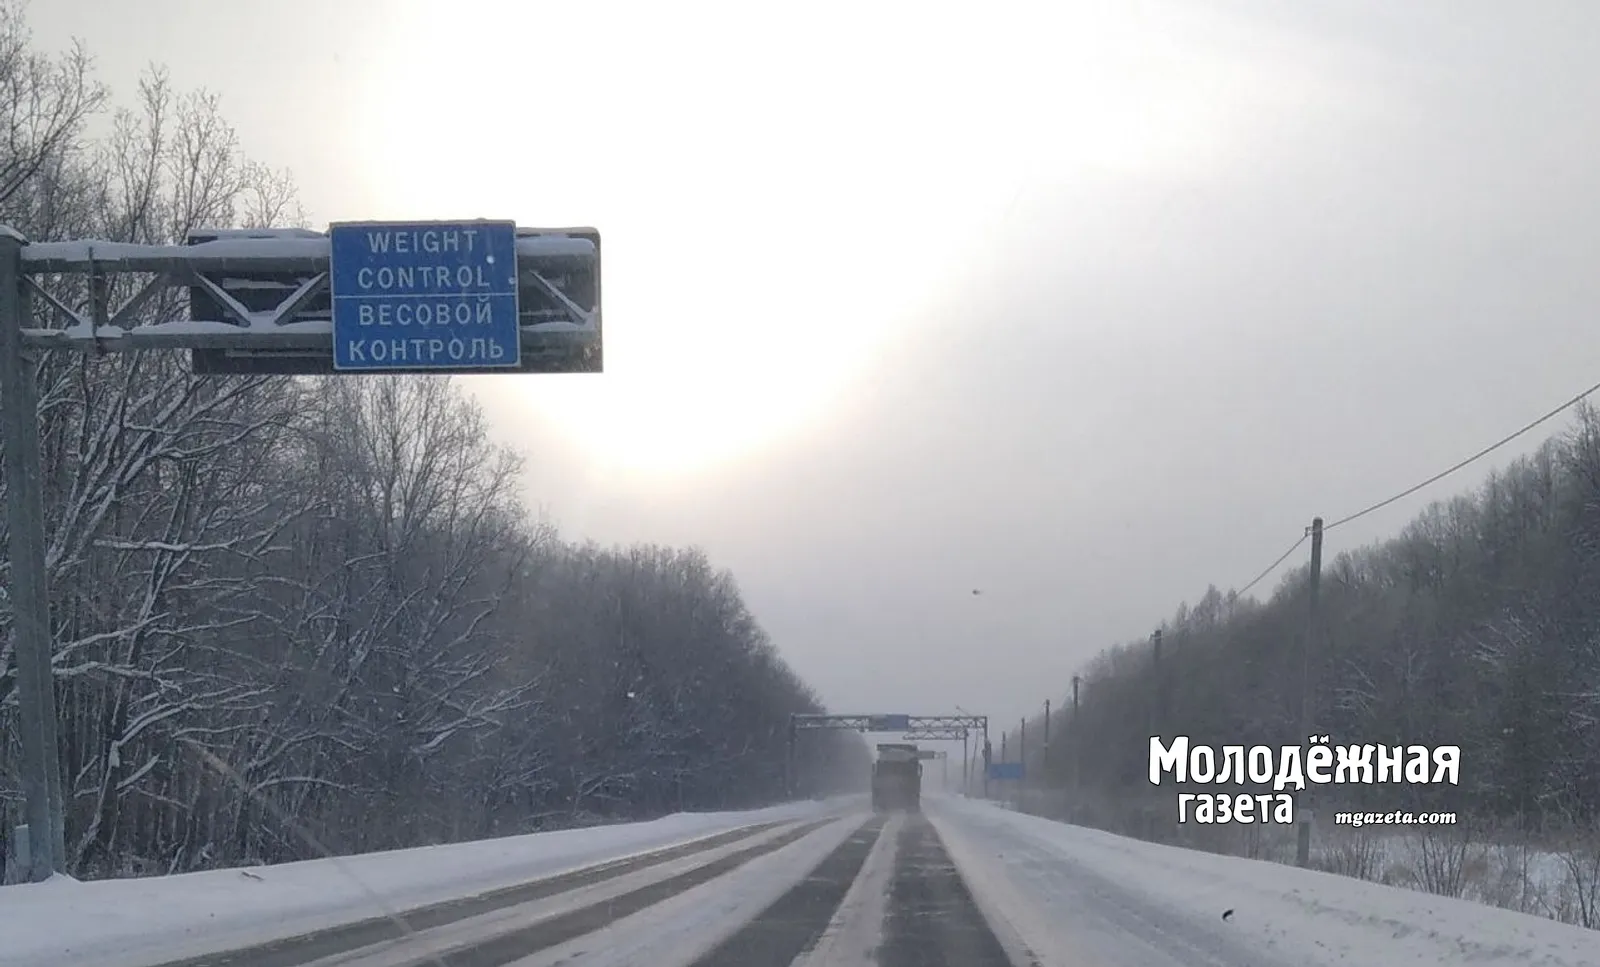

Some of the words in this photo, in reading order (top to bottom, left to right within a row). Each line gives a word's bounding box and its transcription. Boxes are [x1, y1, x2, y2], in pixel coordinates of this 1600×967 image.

[367, 230, 477, 253] WEIGHT
[358, 265, 490, 289] CONTROL
[359, 295, 493, 326] ВЕСОВОЙ
[349, 338, 504, 361] КОНТРОЛЬ
